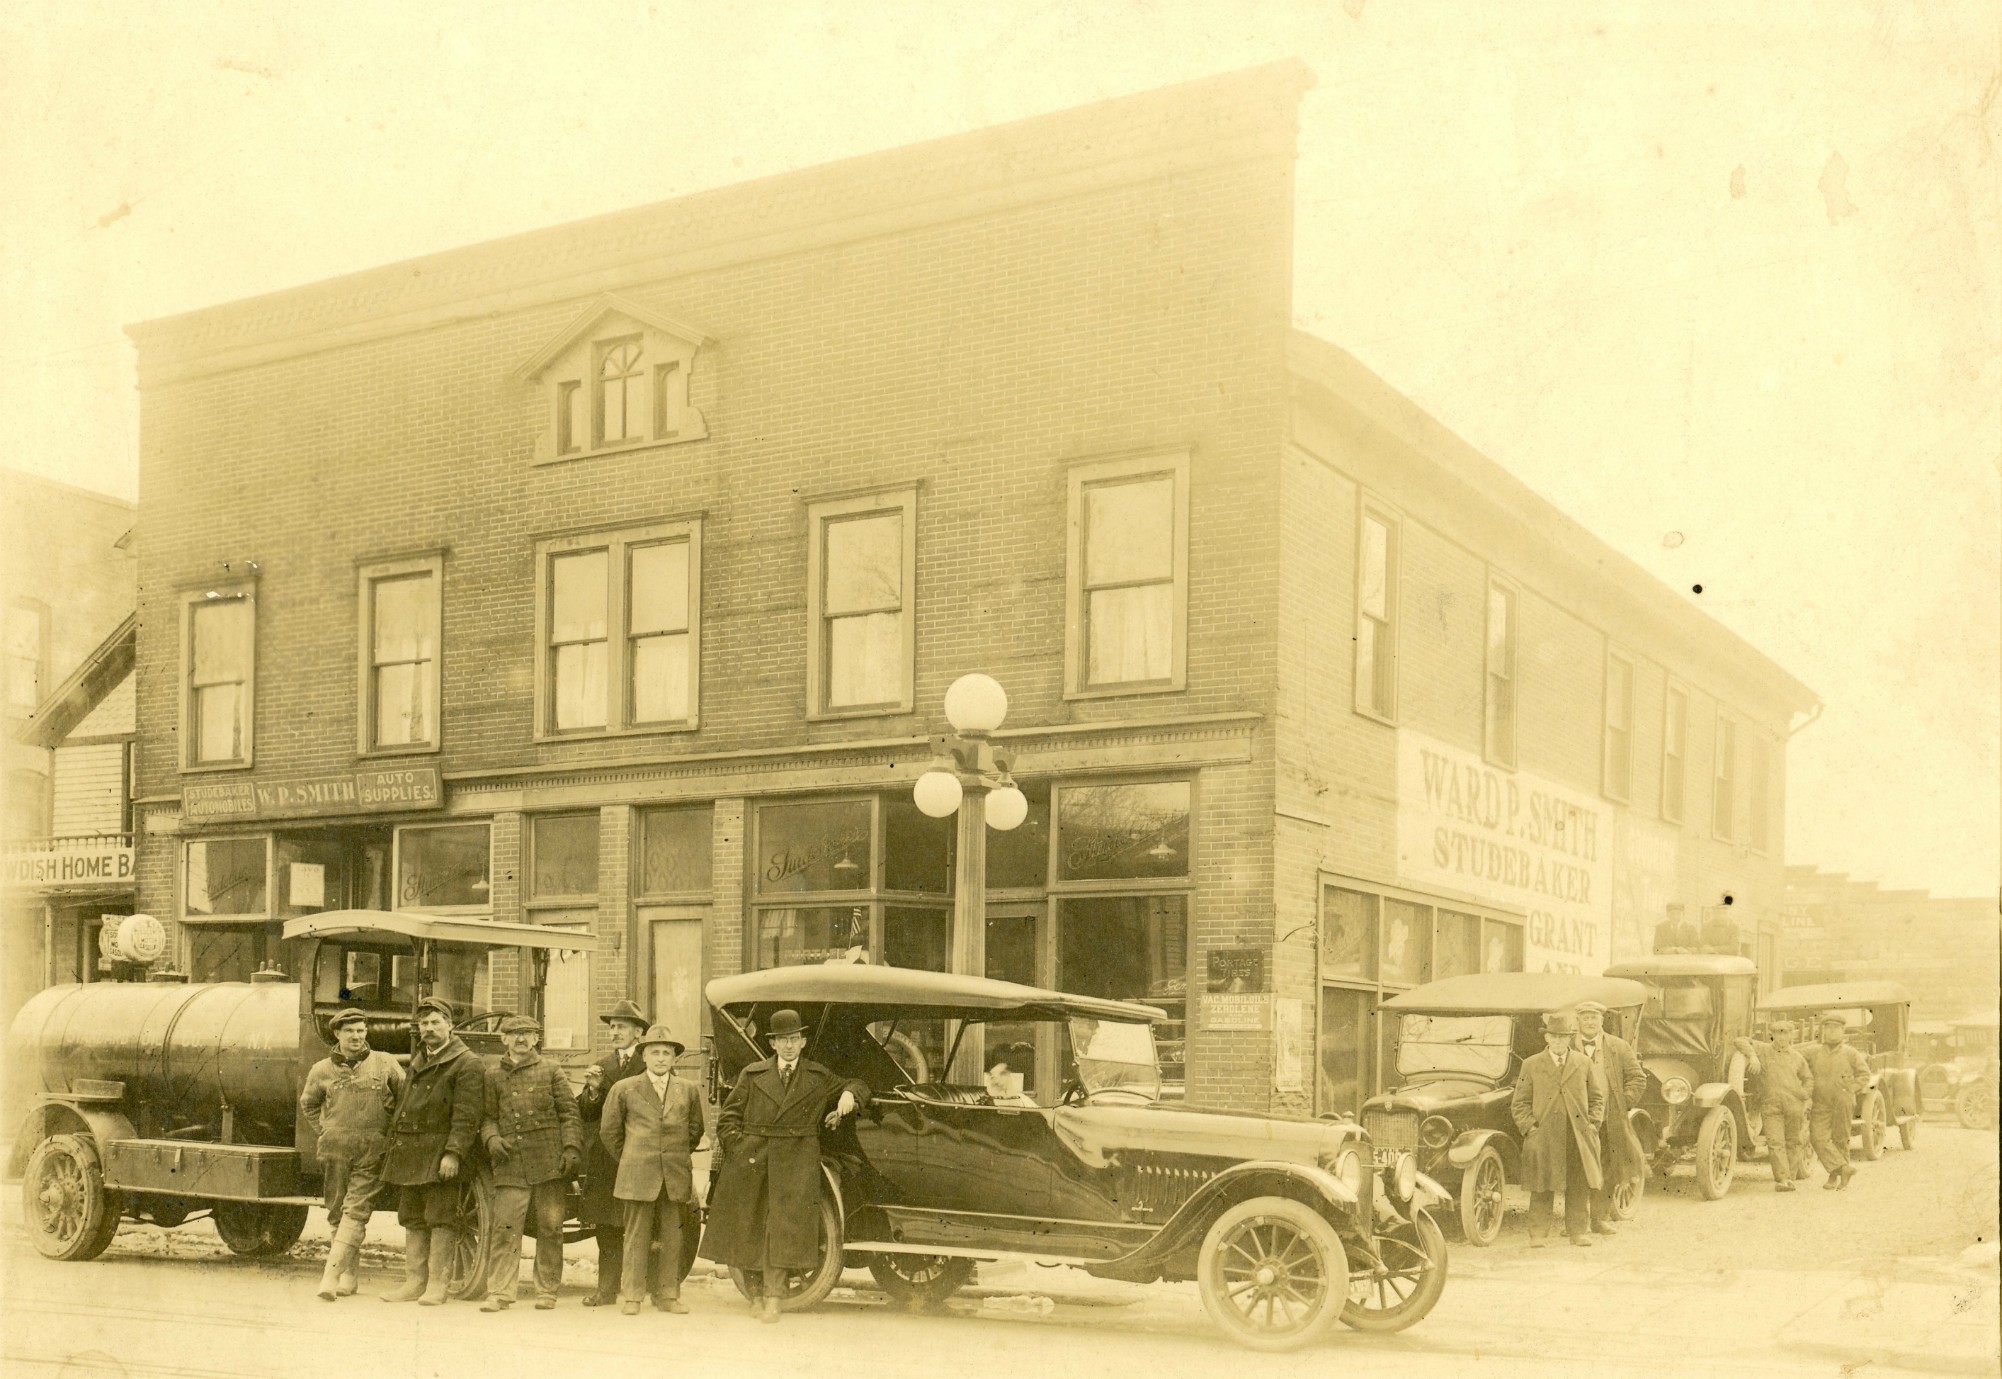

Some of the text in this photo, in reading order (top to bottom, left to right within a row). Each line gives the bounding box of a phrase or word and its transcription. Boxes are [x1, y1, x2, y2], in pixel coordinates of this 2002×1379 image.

[377, 773, 414, 785] AUTO
[189, 785, 251, 800] STUDEBAKER
[297, 781, 356, 803] SMITH
[190, 800, 254, 815] AUTOMOBILES
[1420, 749, 1501, 830] WARD
[1529, 791, 1598, 862] SMITH
[62, 856, 113, 880] HOME
[1433, 827, 1592, 905] STUDEBAKER
[1529, 909, 1598, 957] GRANT
[1213, 956, 1259, 968] PORTAGE
[1220, 968, 1251, 977] TIRES
[1222, 995, 1270, 1004] MOBILOILS
[1210, 1004, 1261, 1014] ZEROLENE
